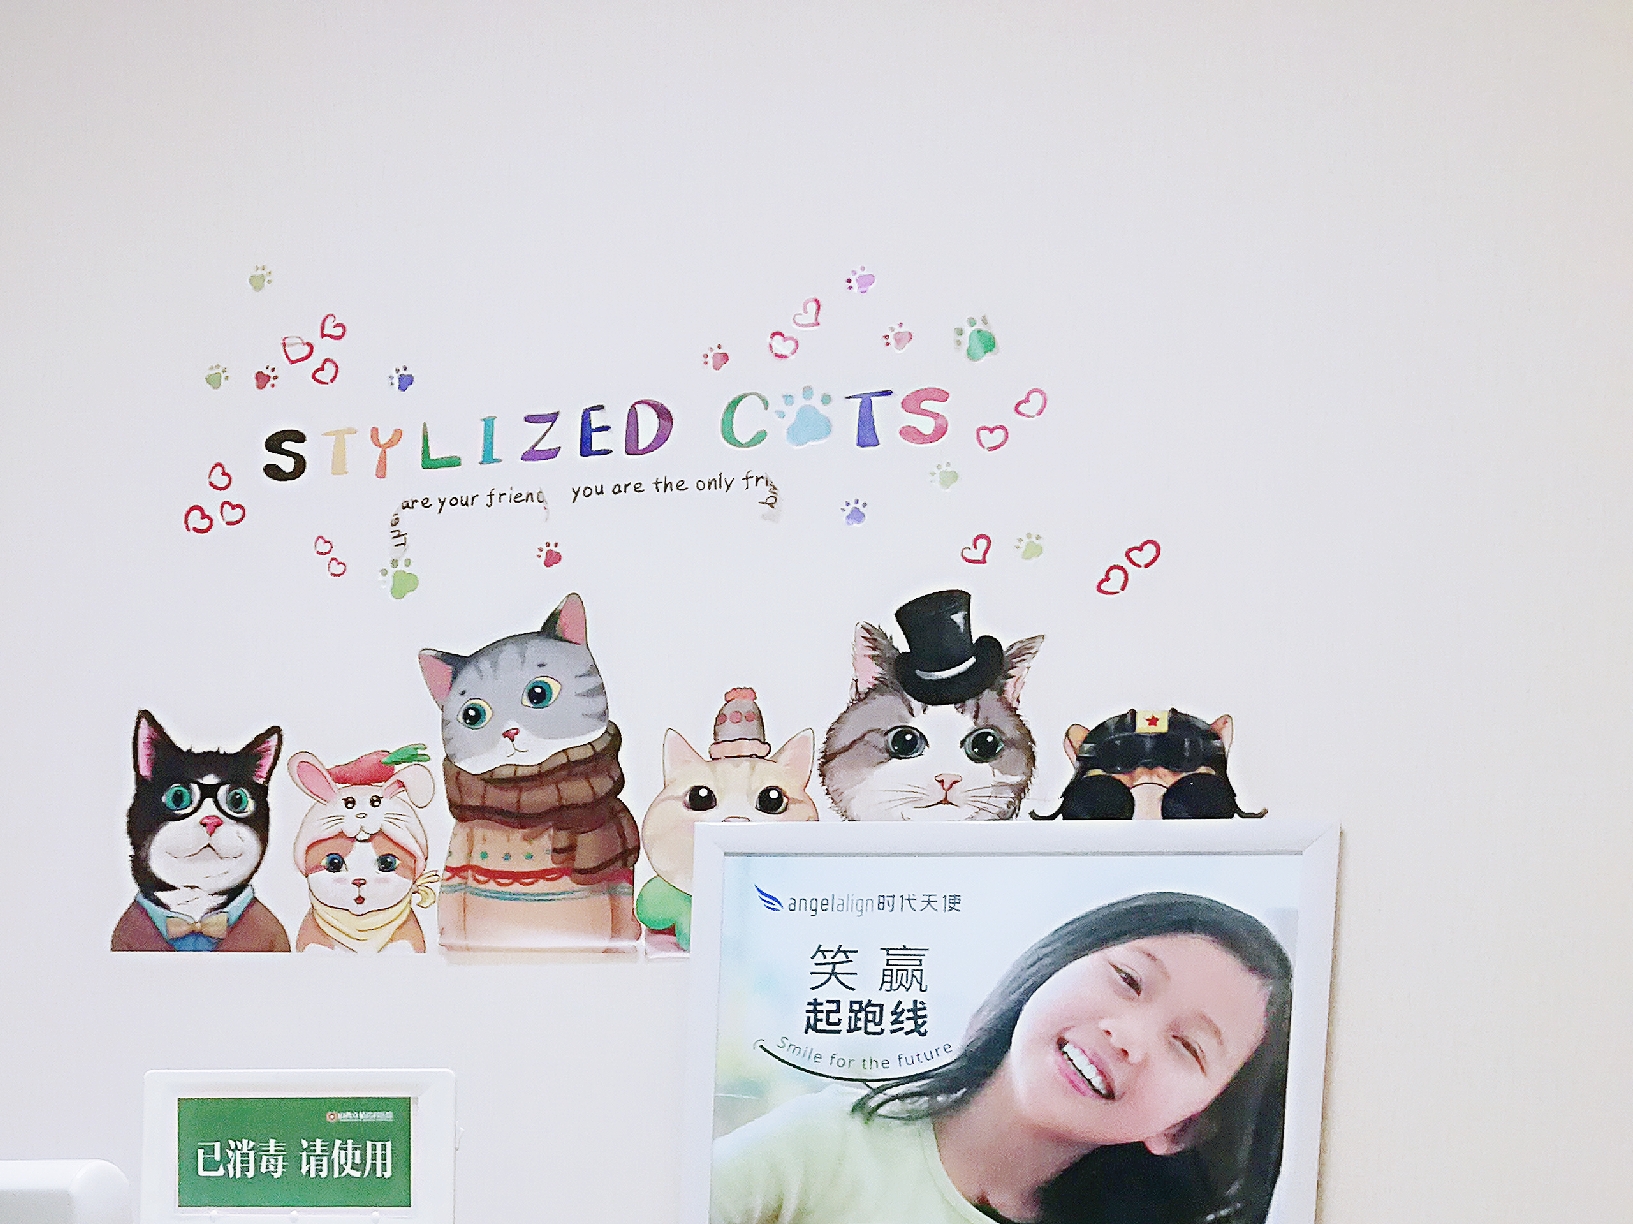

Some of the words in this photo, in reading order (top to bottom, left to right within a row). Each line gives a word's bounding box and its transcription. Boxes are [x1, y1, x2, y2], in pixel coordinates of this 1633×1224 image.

[263, 398, 674, 481] STYLIZED
[721, 386, 951, 449] CTS
[401, 496, 433, 510] are
[437, 495, 479, 514] your
[572, 486, 604, 503] you
[611, 479, 646, 494] are
[654, 476, 689, 493] the
[696, 473, 735, 492] only
[804, 997, 929, 1037] 起跑线
[777, 1036, 823, 1064] Smile
[829, 1053, 855, 1069] for
[862, 1055, 891, 1070] the
[897, 1042, 954, 1067] future
[197, 1138, 288, 1179] 已消毒
[300, 1137, 393, 1179] 请使用
